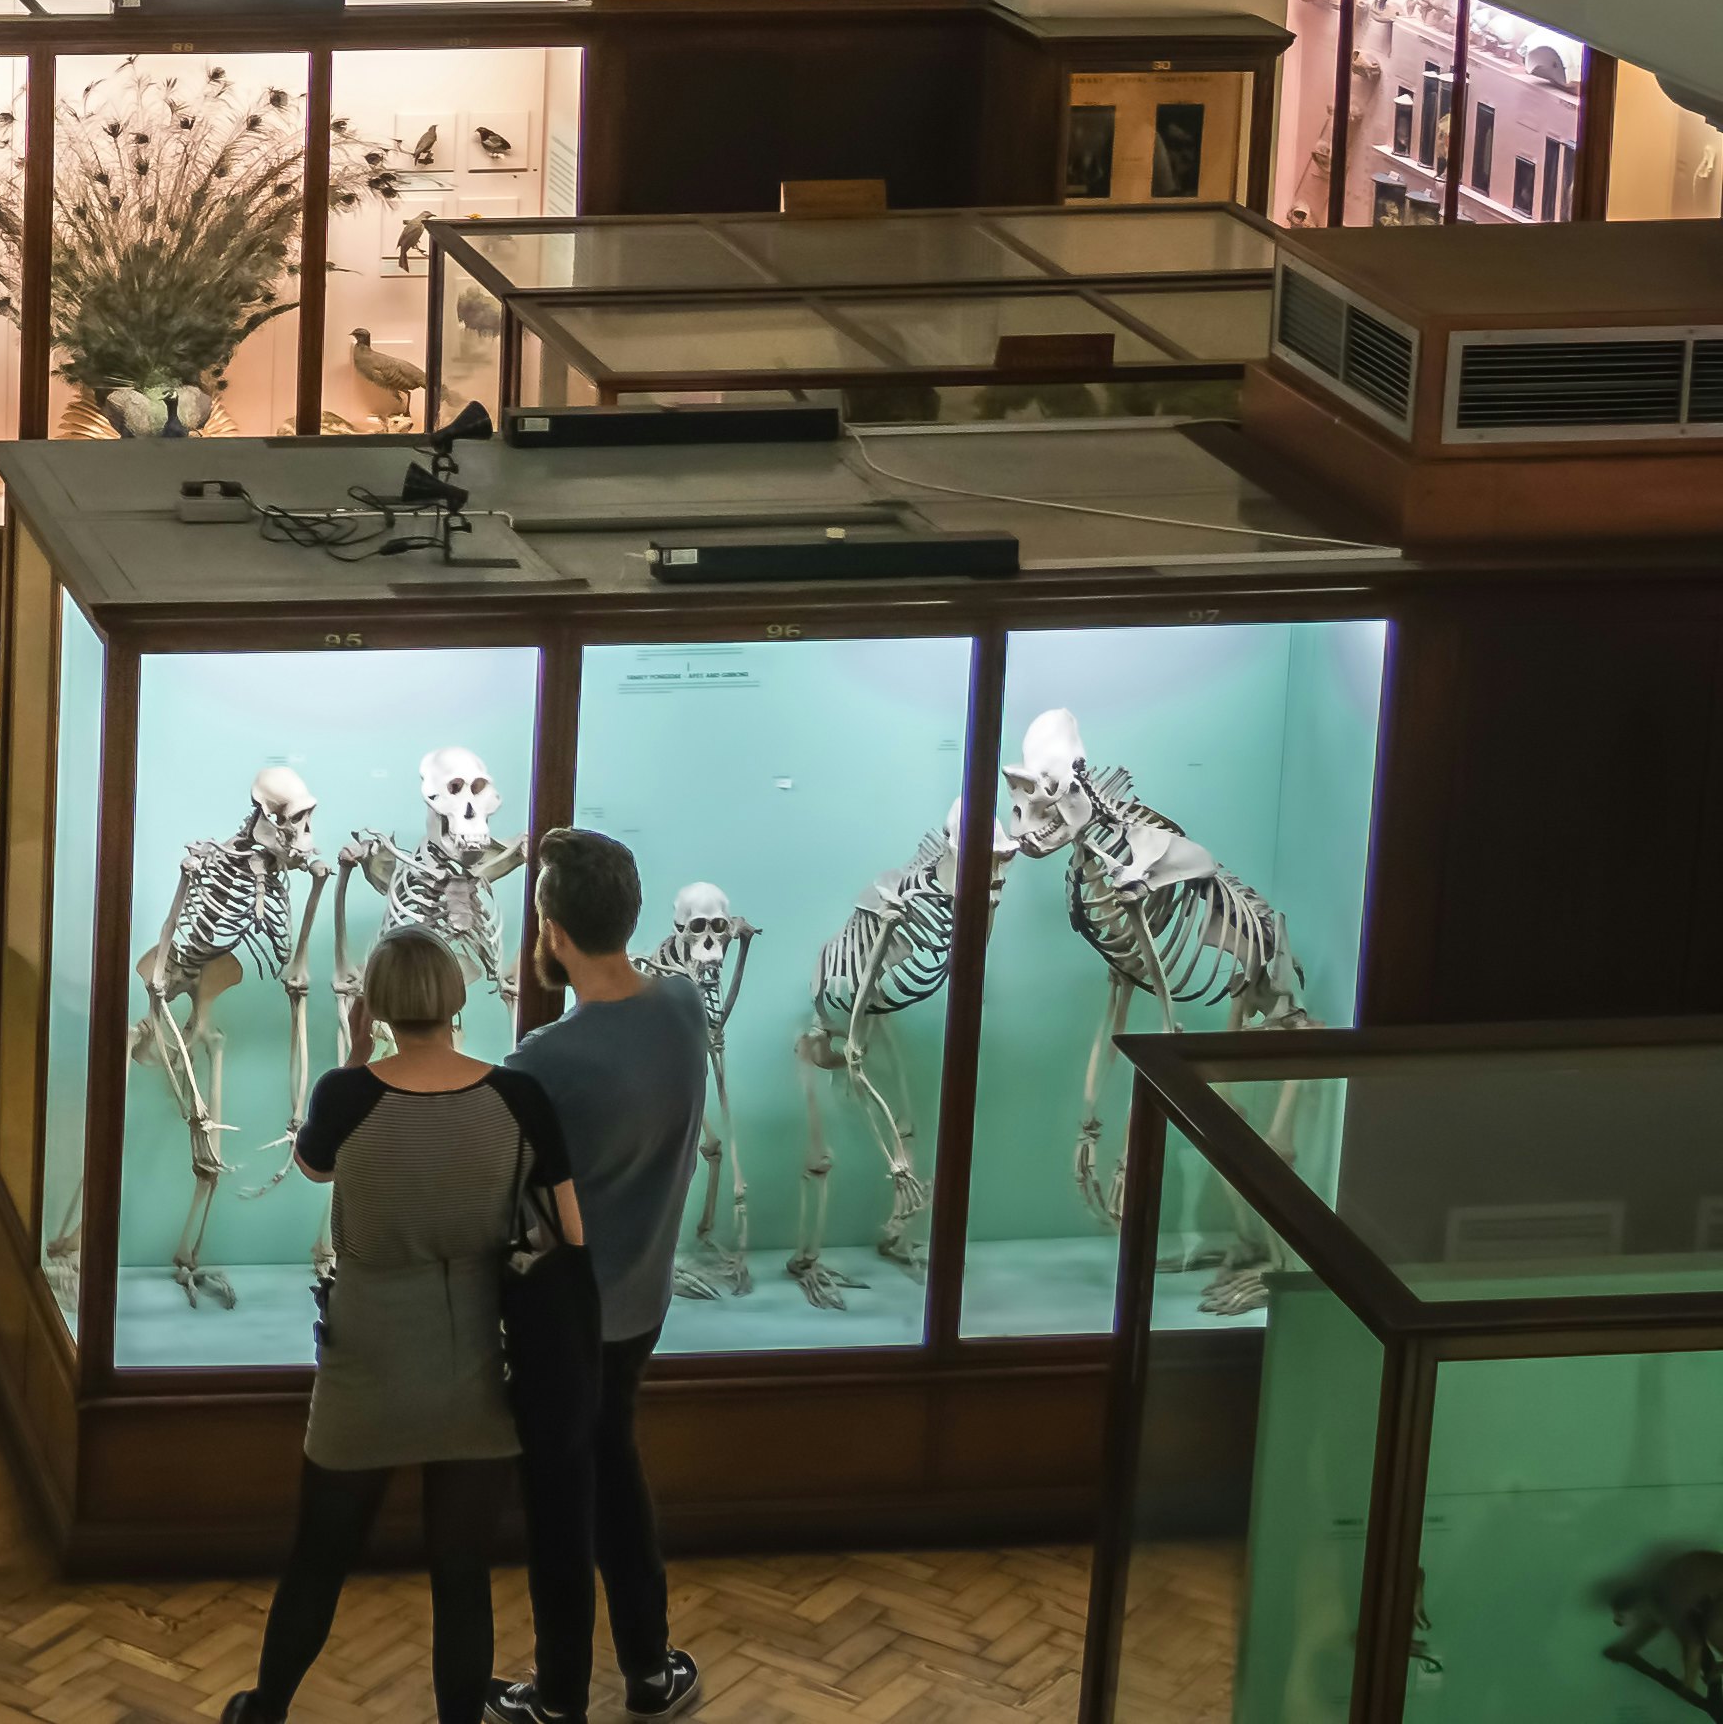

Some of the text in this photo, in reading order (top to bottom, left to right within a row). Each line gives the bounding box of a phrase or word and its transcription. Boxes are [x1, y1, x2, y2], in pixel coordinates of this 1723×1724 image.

[1187, 609, 1220, 623] 97
[766, 624, 801, 638] 96
[325, 633, 362, 647] 95
